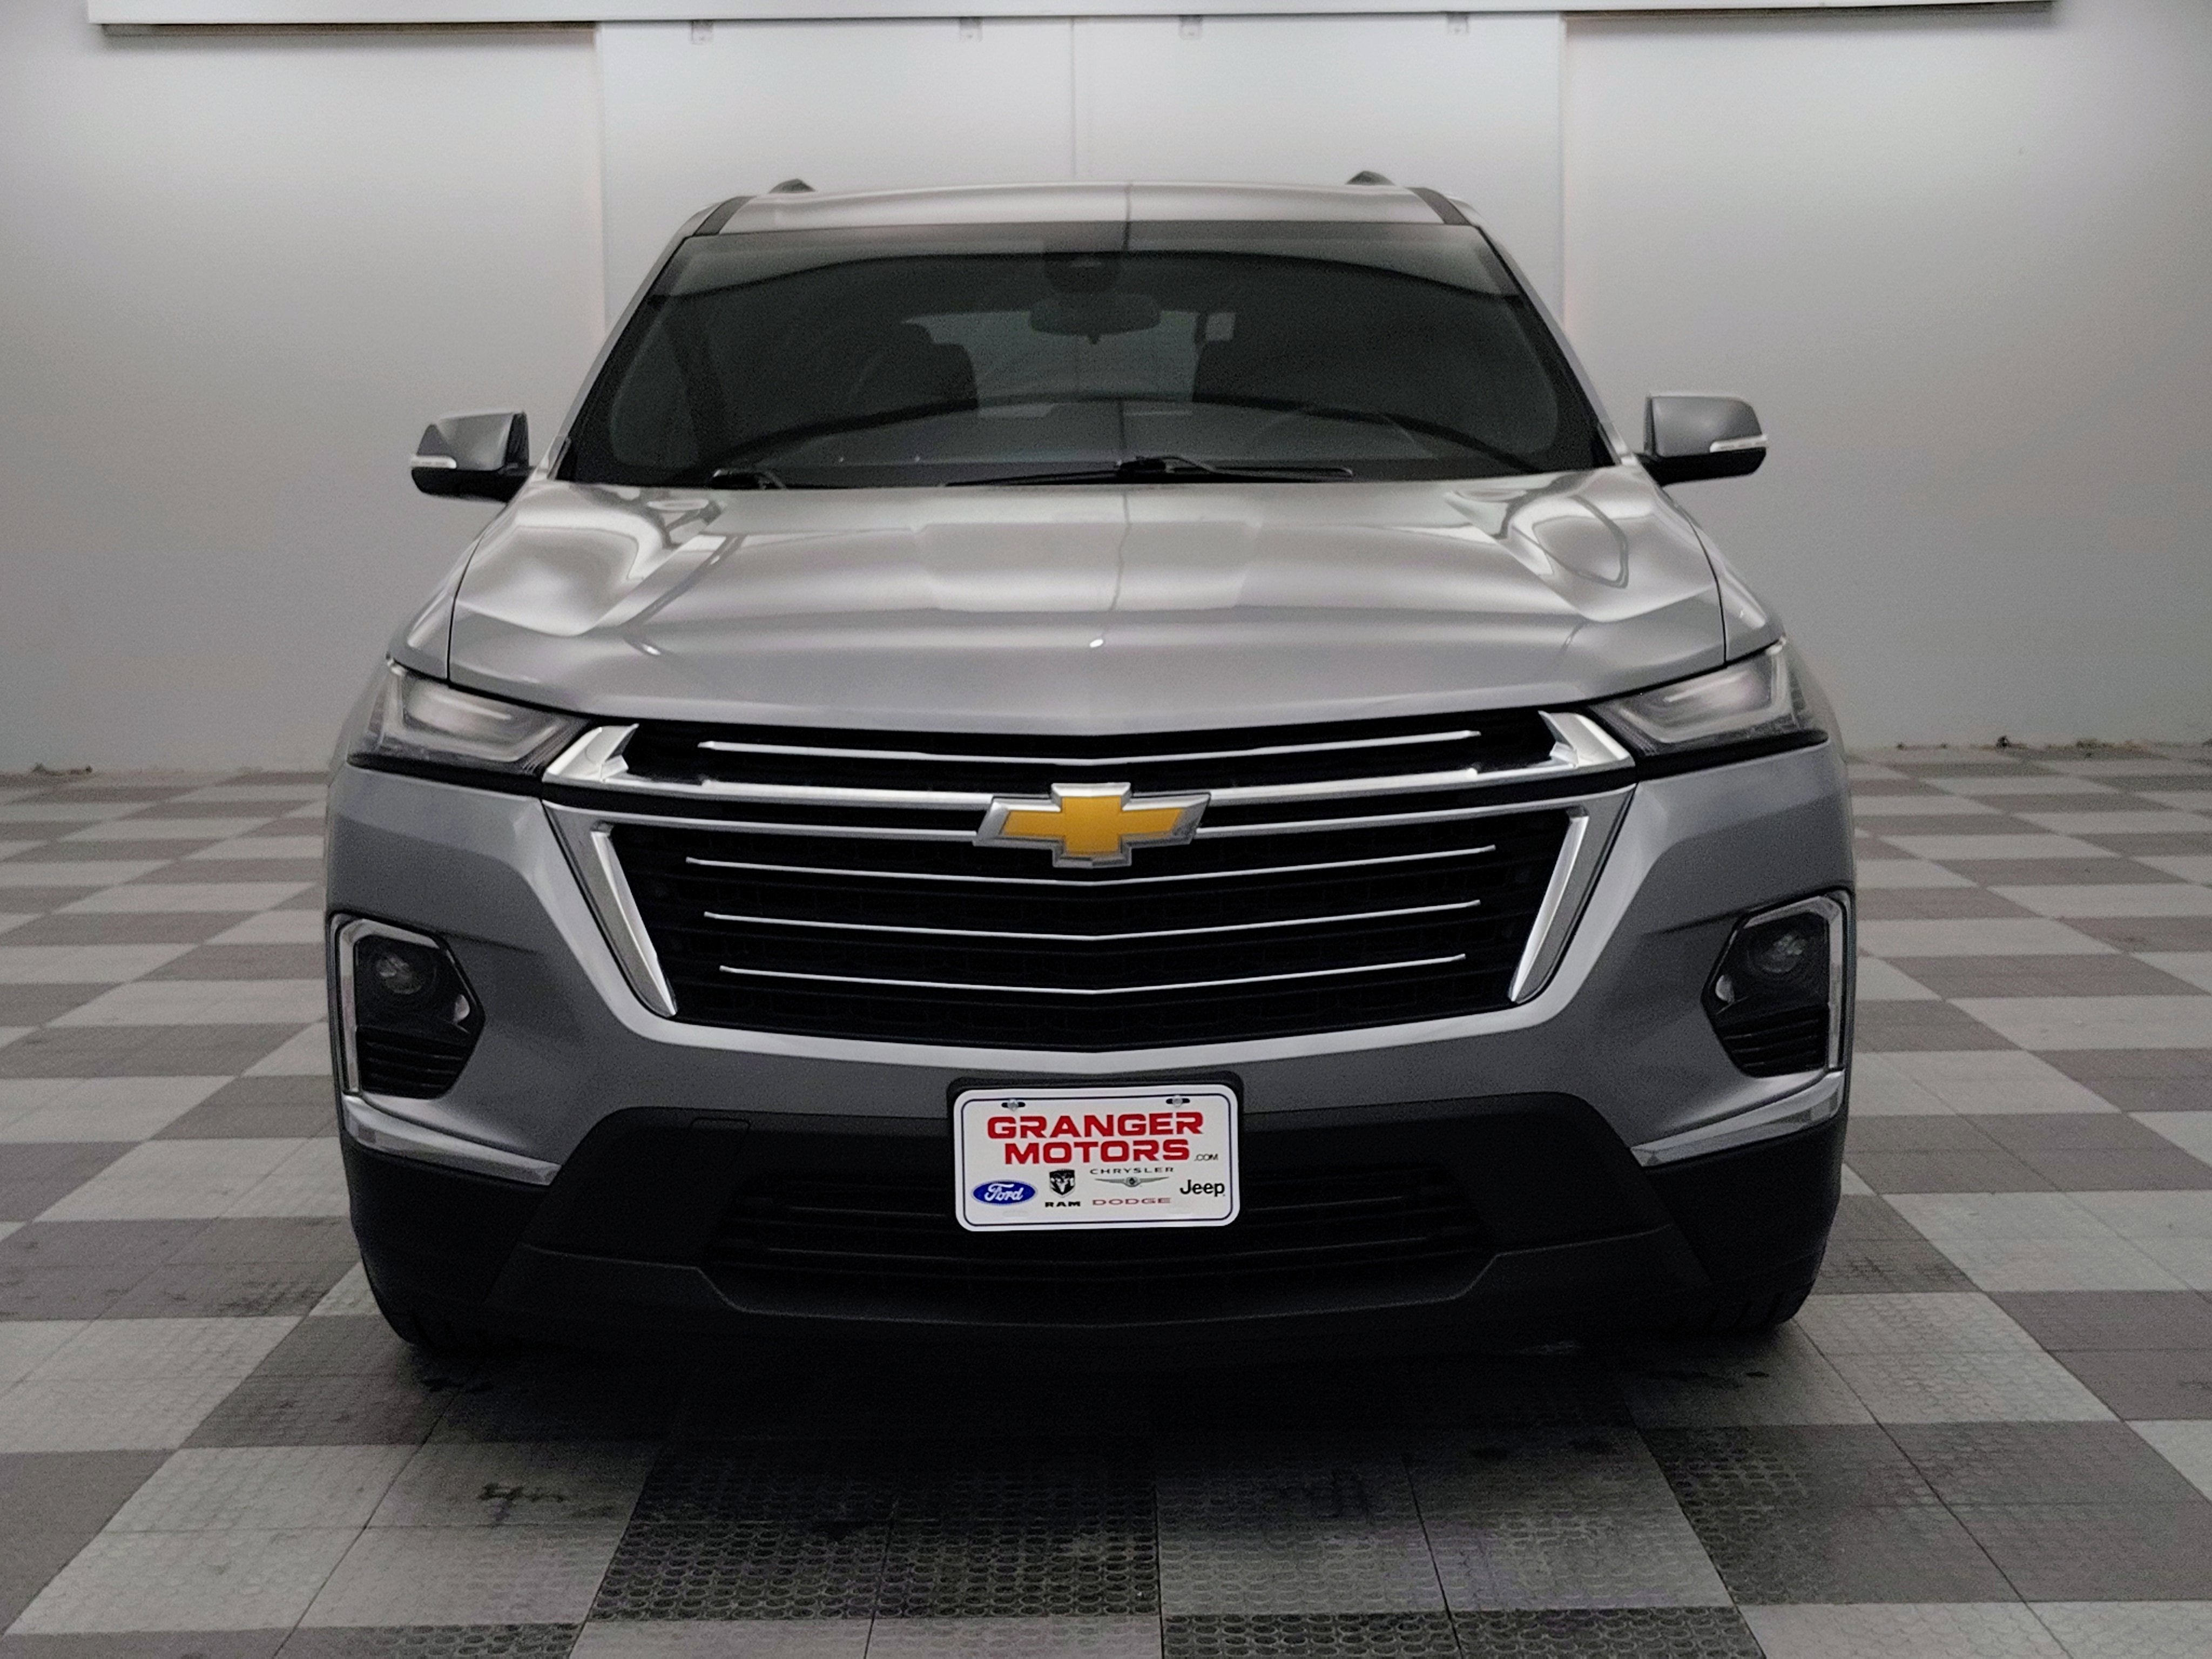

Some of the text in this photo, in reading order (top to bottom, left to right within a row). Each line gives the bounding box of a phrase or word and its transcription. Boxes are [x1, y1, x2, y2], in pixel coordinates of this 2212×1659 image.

[987, 1111, 1204, 1139] GRANGER
[1004, 1138, 1190, 1165] MOTORS
[1090, 1166, 1175, 1175] CHRYSLER
[983, 1183, 1024, 1202] Ford
[1179, 1179, 1225, 1197] Jeep
[1092, 1197, 1172, 1206] DODGE
